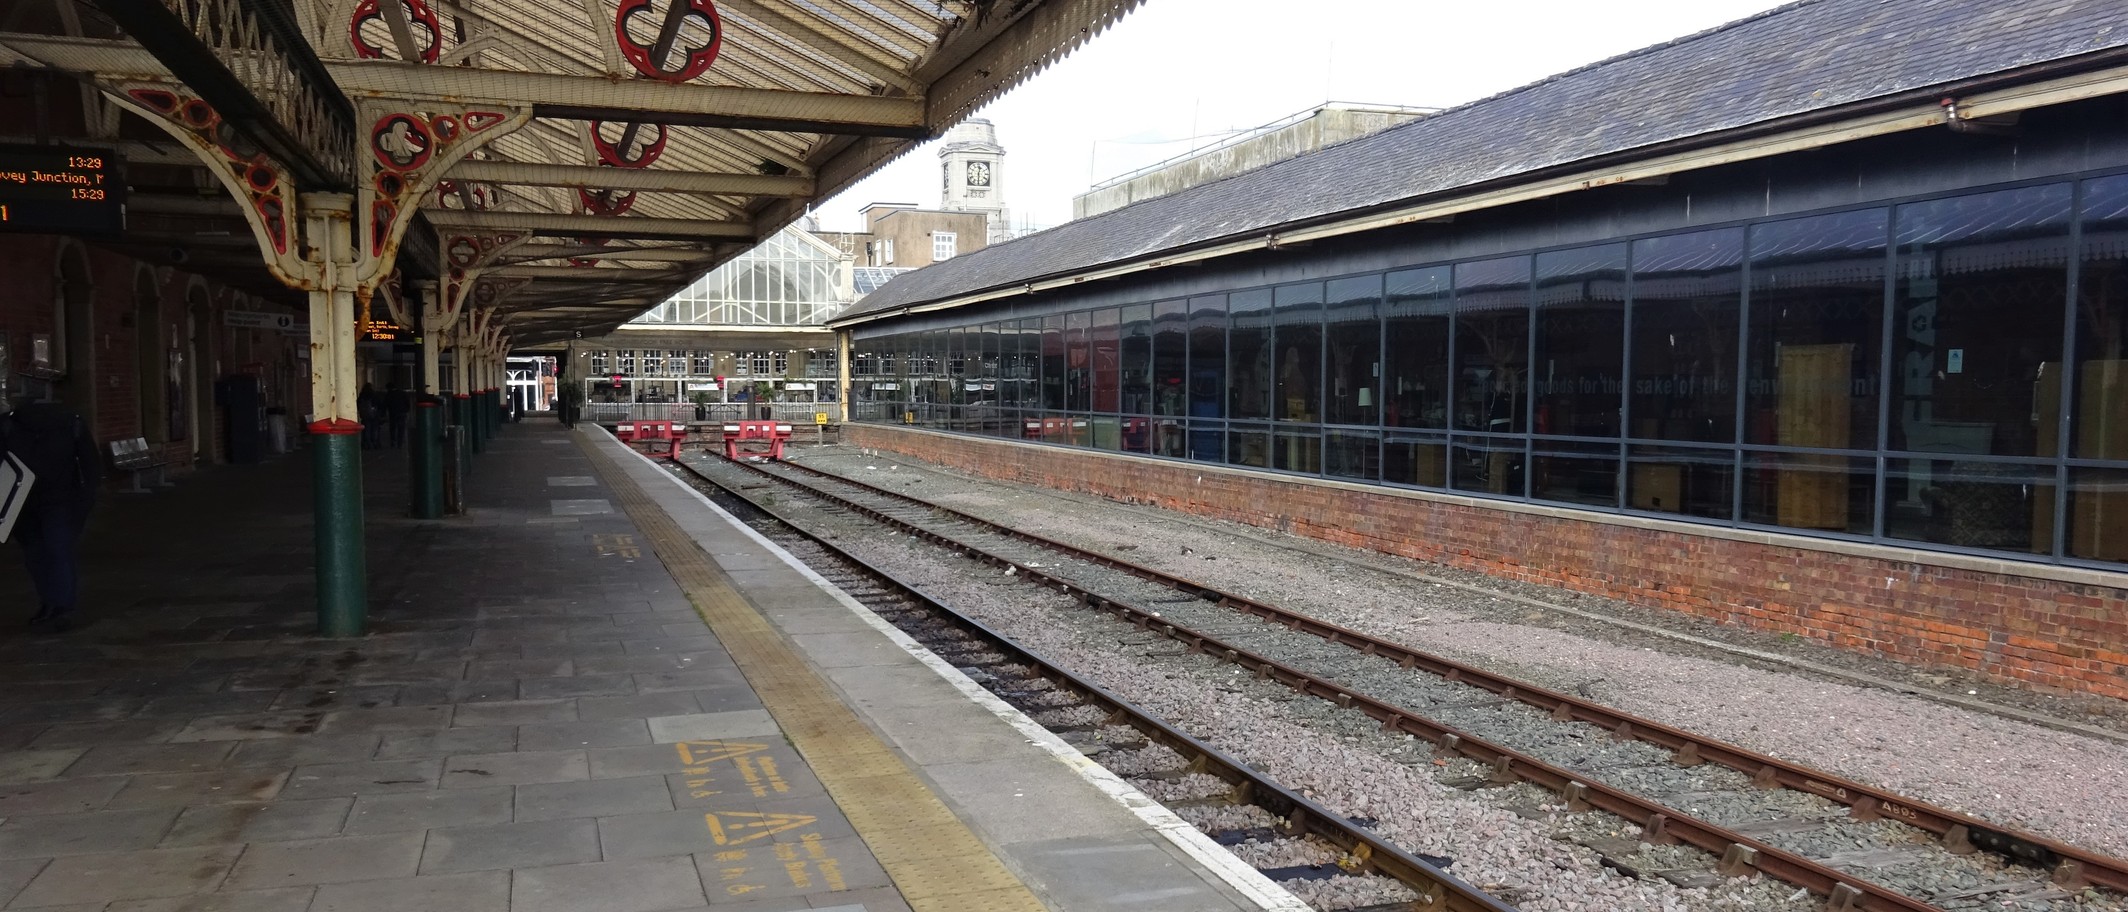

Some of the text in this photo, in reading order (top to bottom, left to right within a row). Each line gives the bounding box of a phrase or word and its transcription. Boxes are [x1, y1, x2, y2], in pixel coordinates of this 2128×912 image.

[68, 156, 102, 168] 13:29
[0, 172, 27, 184] vey
[31, 170, 91, 186] Junction,
[71, 188, 104, 200] 15:29
[576, 330, 582, 338] S
[1538, 374, 1573, 397] goods
[1579, 375, 1597, 395] for
[1601, 374, 1625, 395] the
[1636, 374, 1672, 395] sake
[1678, 374, 1696, 395] of
[1703, 374, 1729, 395] the
